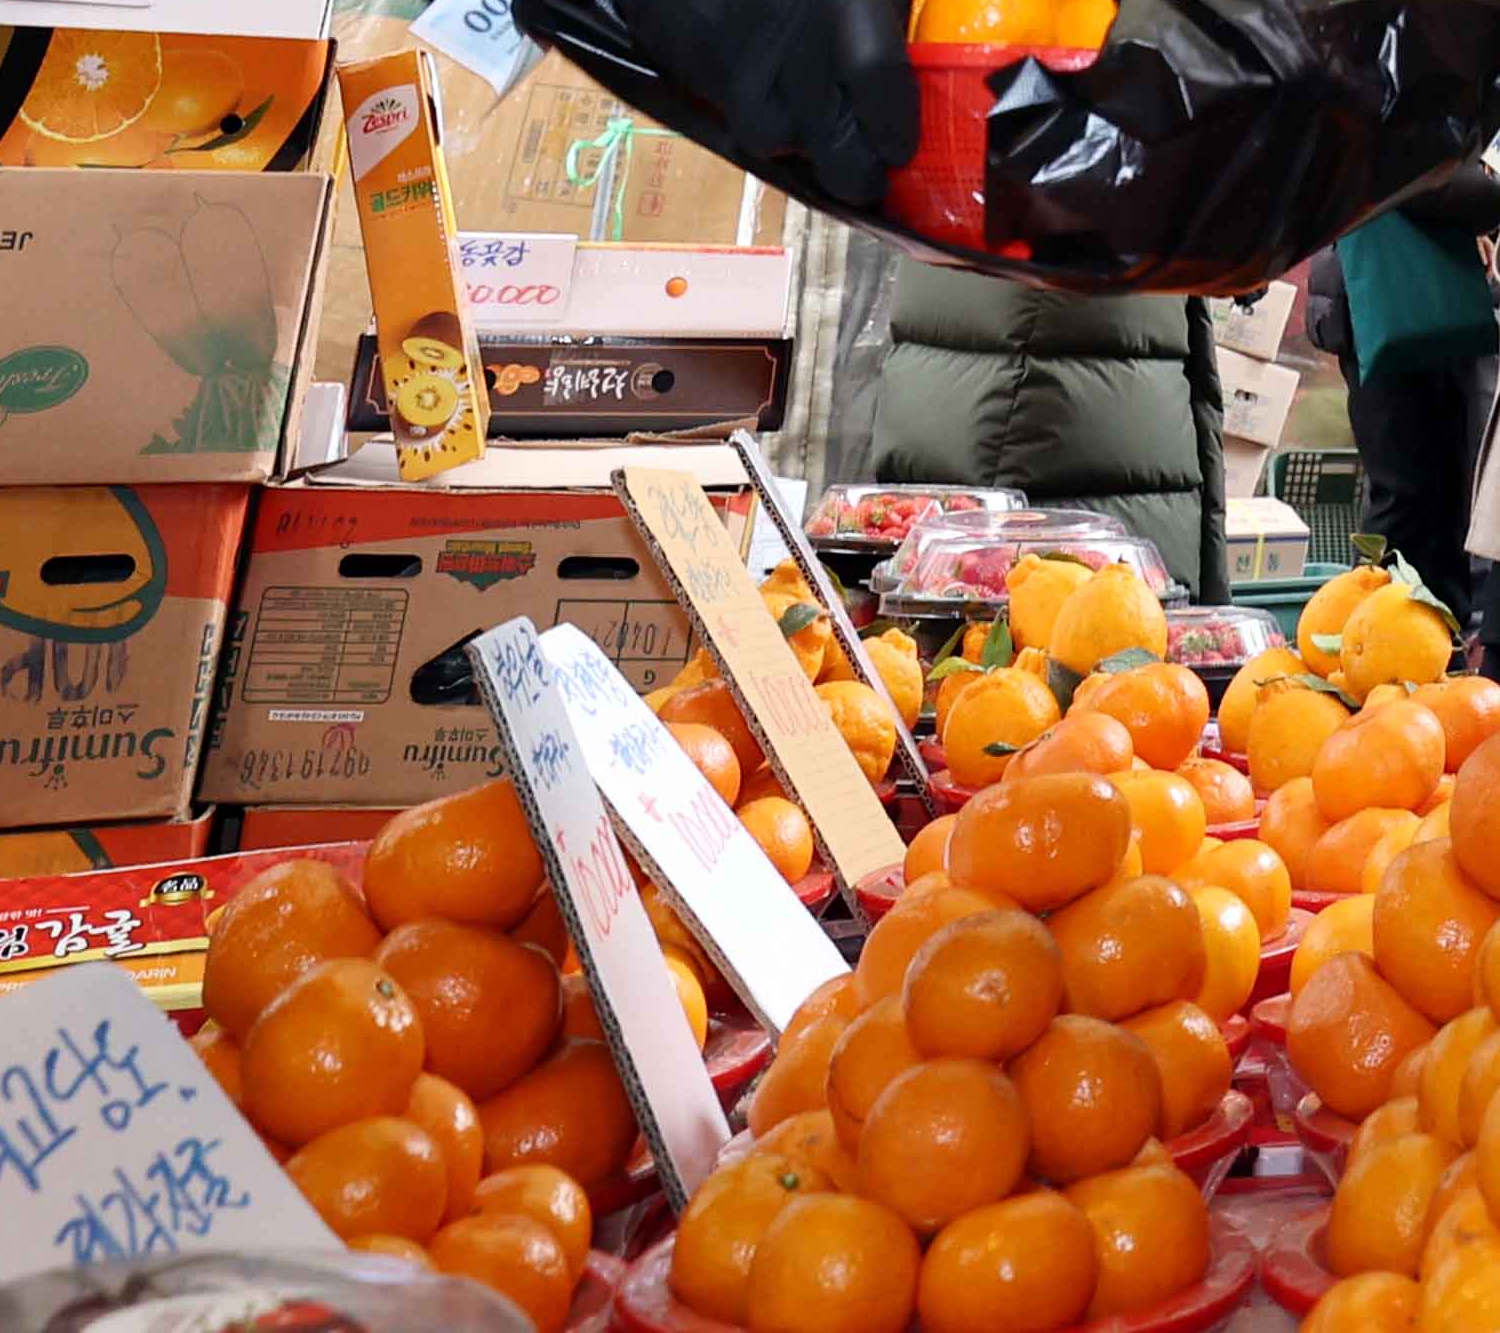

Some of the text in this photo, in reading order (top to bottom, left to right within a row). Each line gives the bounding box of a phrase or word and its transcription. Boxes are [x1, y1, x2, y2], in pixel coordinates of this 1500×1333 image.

[361, 107, 408, 134] Zespri
[370, 179, 433, 213] 골드키위
[544, 366, 628, 400] 천혜향
[47, 704, 139, 730] 스미후루
[402, 743, 506, 777] Sumifru
[35, 909, 146, 958] 감귤
